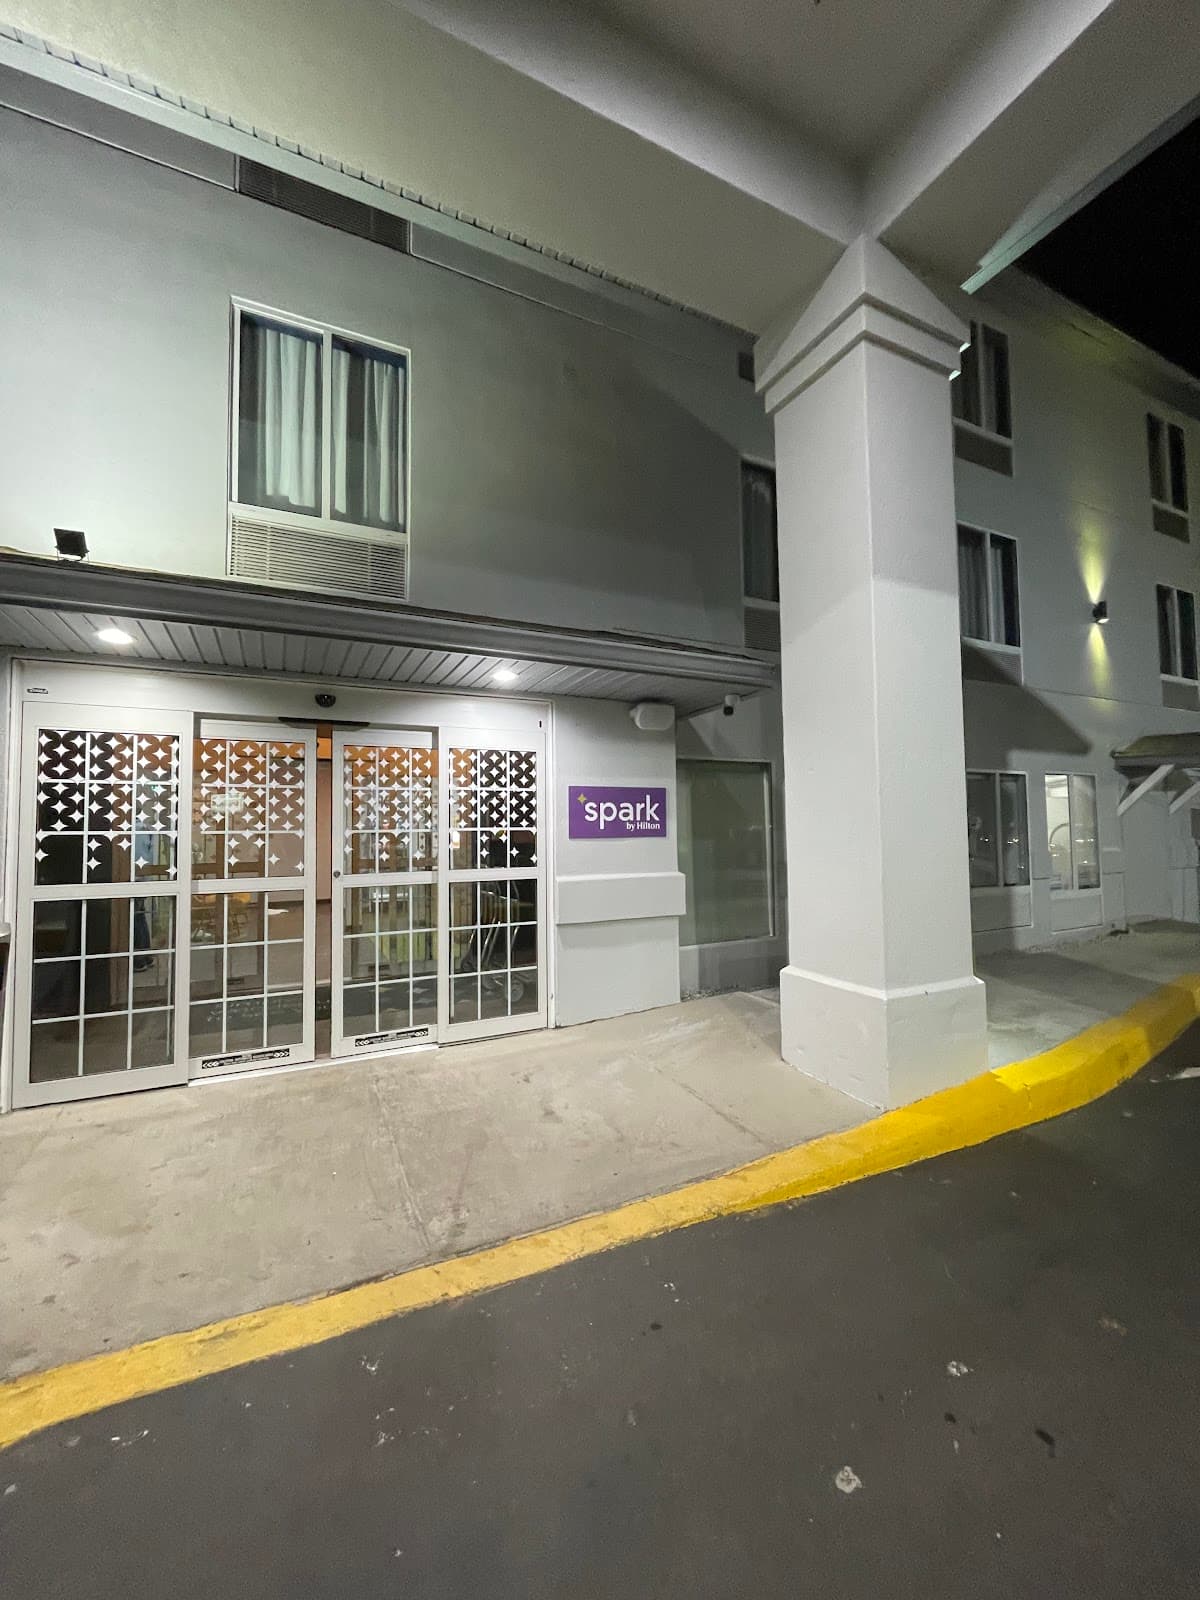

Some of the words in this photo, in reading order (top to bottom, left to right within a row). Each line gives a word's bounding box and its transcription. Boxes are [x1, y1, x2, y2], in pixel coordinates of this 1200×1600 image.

[584, 794, 660, 830] spark
[626, 822, 636, 831] by
[637, 821, 660, 830] Hilton
